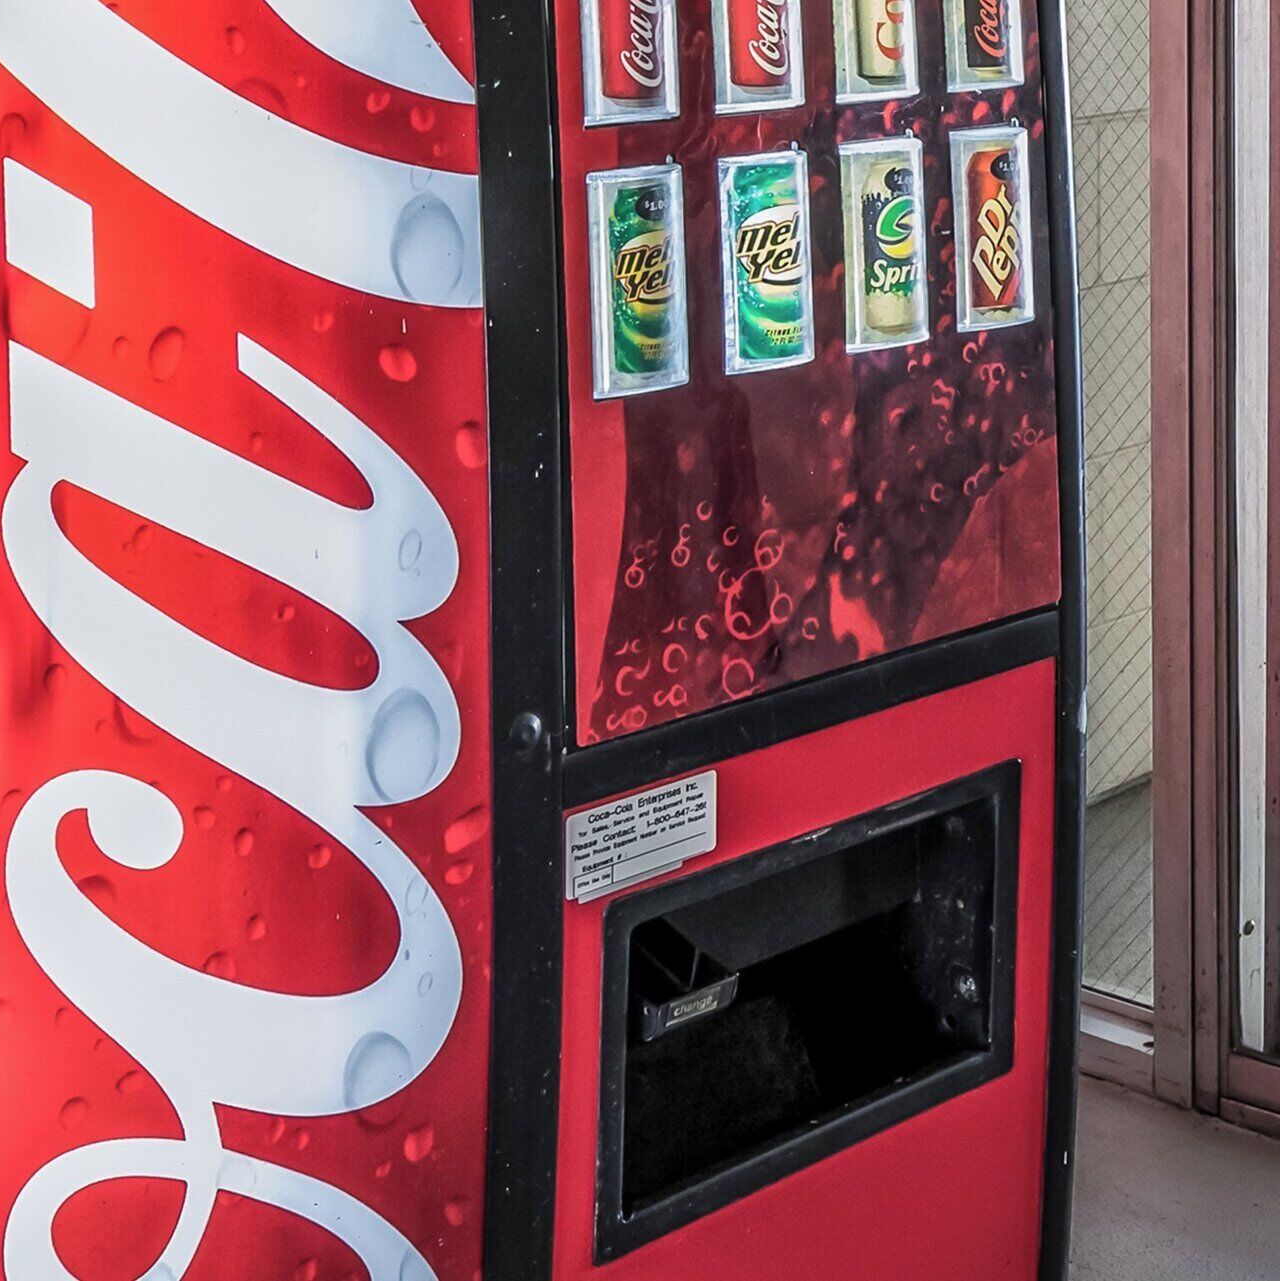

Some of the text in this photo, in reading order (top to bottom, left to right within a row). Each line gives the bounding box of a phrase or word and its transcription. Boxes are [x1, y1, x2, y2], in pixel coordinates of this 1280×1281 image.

[977, 184, 1012, 247] Dr
[588, 803, 633, 824] Coca-Cola
[638, 787, 681, 809] Enterprises
[652, 799, 683, 814] Equipment
[571, 839, 597, 853] Please
[582, 856, 614, 873] Equipment
[674, 996, 713, 1017] change
